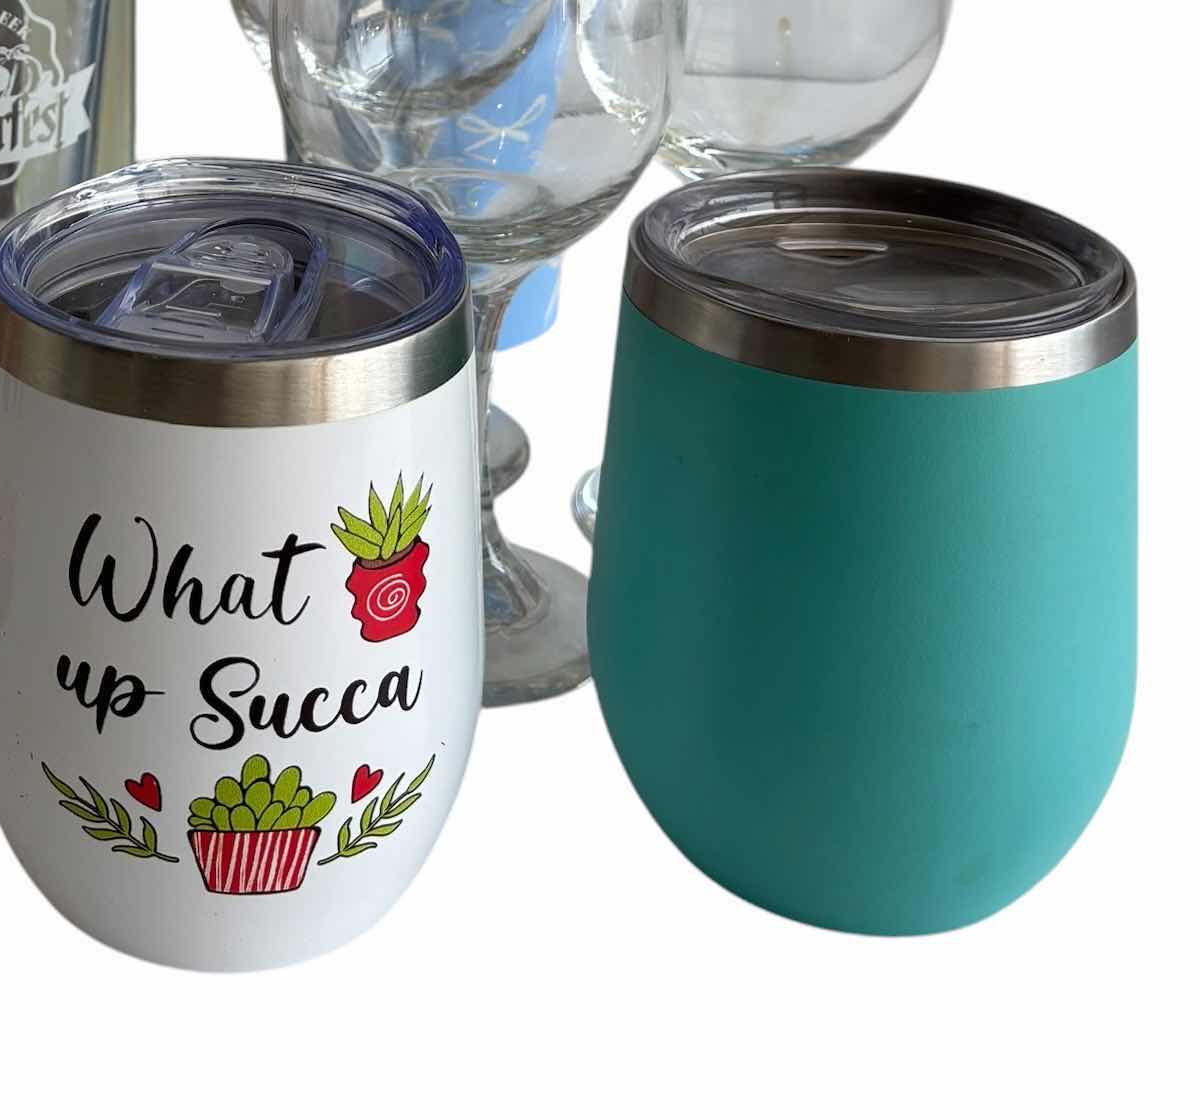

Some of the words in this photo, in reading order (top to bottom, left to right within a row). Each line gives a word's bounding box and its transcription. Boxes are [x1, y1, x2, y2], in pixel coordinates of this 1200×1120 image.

[68, 512, 326, 625] What
[56, 654, 165, 734] up
[190, 656, 424, 750] Succa
